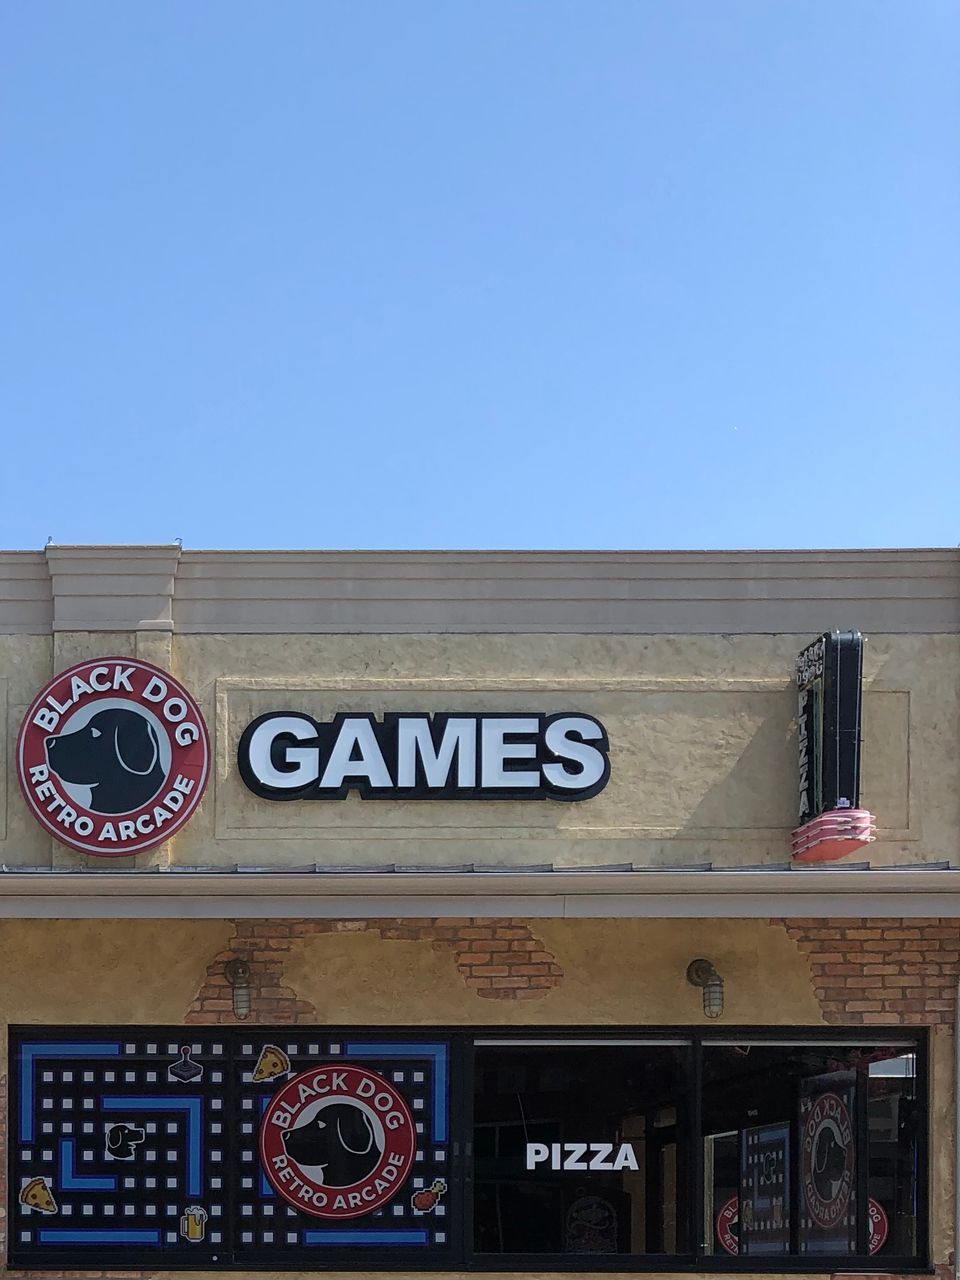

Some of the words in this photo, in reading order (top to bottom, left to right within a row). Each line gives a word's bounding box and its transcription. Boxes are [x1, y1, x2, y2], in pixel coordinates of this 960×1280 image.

[33, 666, 136, 733] BLACK
[142, 675, 200, 747] DOG
[247, 716, 607, 790] GAMES
[798, 689, 810, 818] PIZZA
[29, 763, 94, 836] RETRO
[98, 773, 196, 842] ARCADE
[270, 1072, 349, 1129] BLACK
[355, 1078, 405, 1131] DOG
[271, 1153, 328, 1209] RETRO
[332, 1151, 405, 1211] ARCADE
[526, 1143, 640, 1171] PIZZA
[869, 1207, 881, 1222] OG
